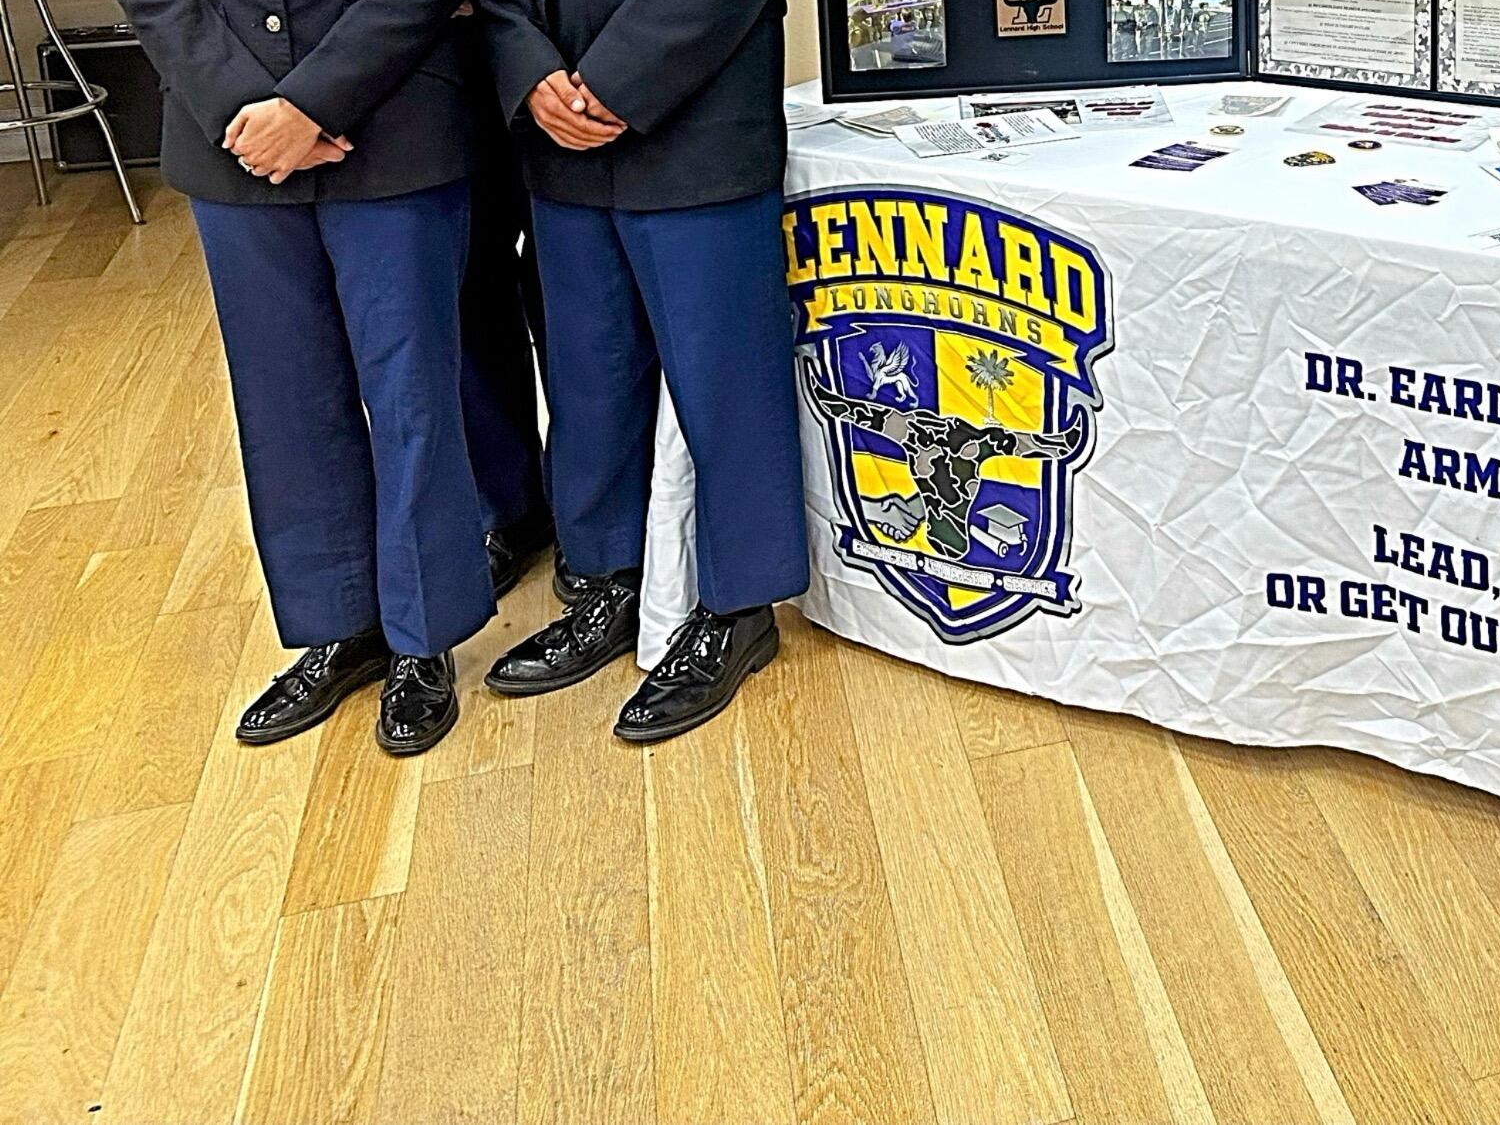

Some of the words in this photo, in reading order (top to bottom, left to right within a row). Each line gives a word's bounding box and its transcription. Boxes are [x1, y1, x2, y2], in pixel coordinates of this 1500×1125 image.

[782, 199, 1098, 335] LENNARD
[831, 285, 1042, 345] LONGHORNS
[1304, 352, 1377, 402] DR.
[1373, 524, 1500, 601] LEAD,
[1266, 573, 1327, 614] OR
[1340, 579, 1428, 632] GET
